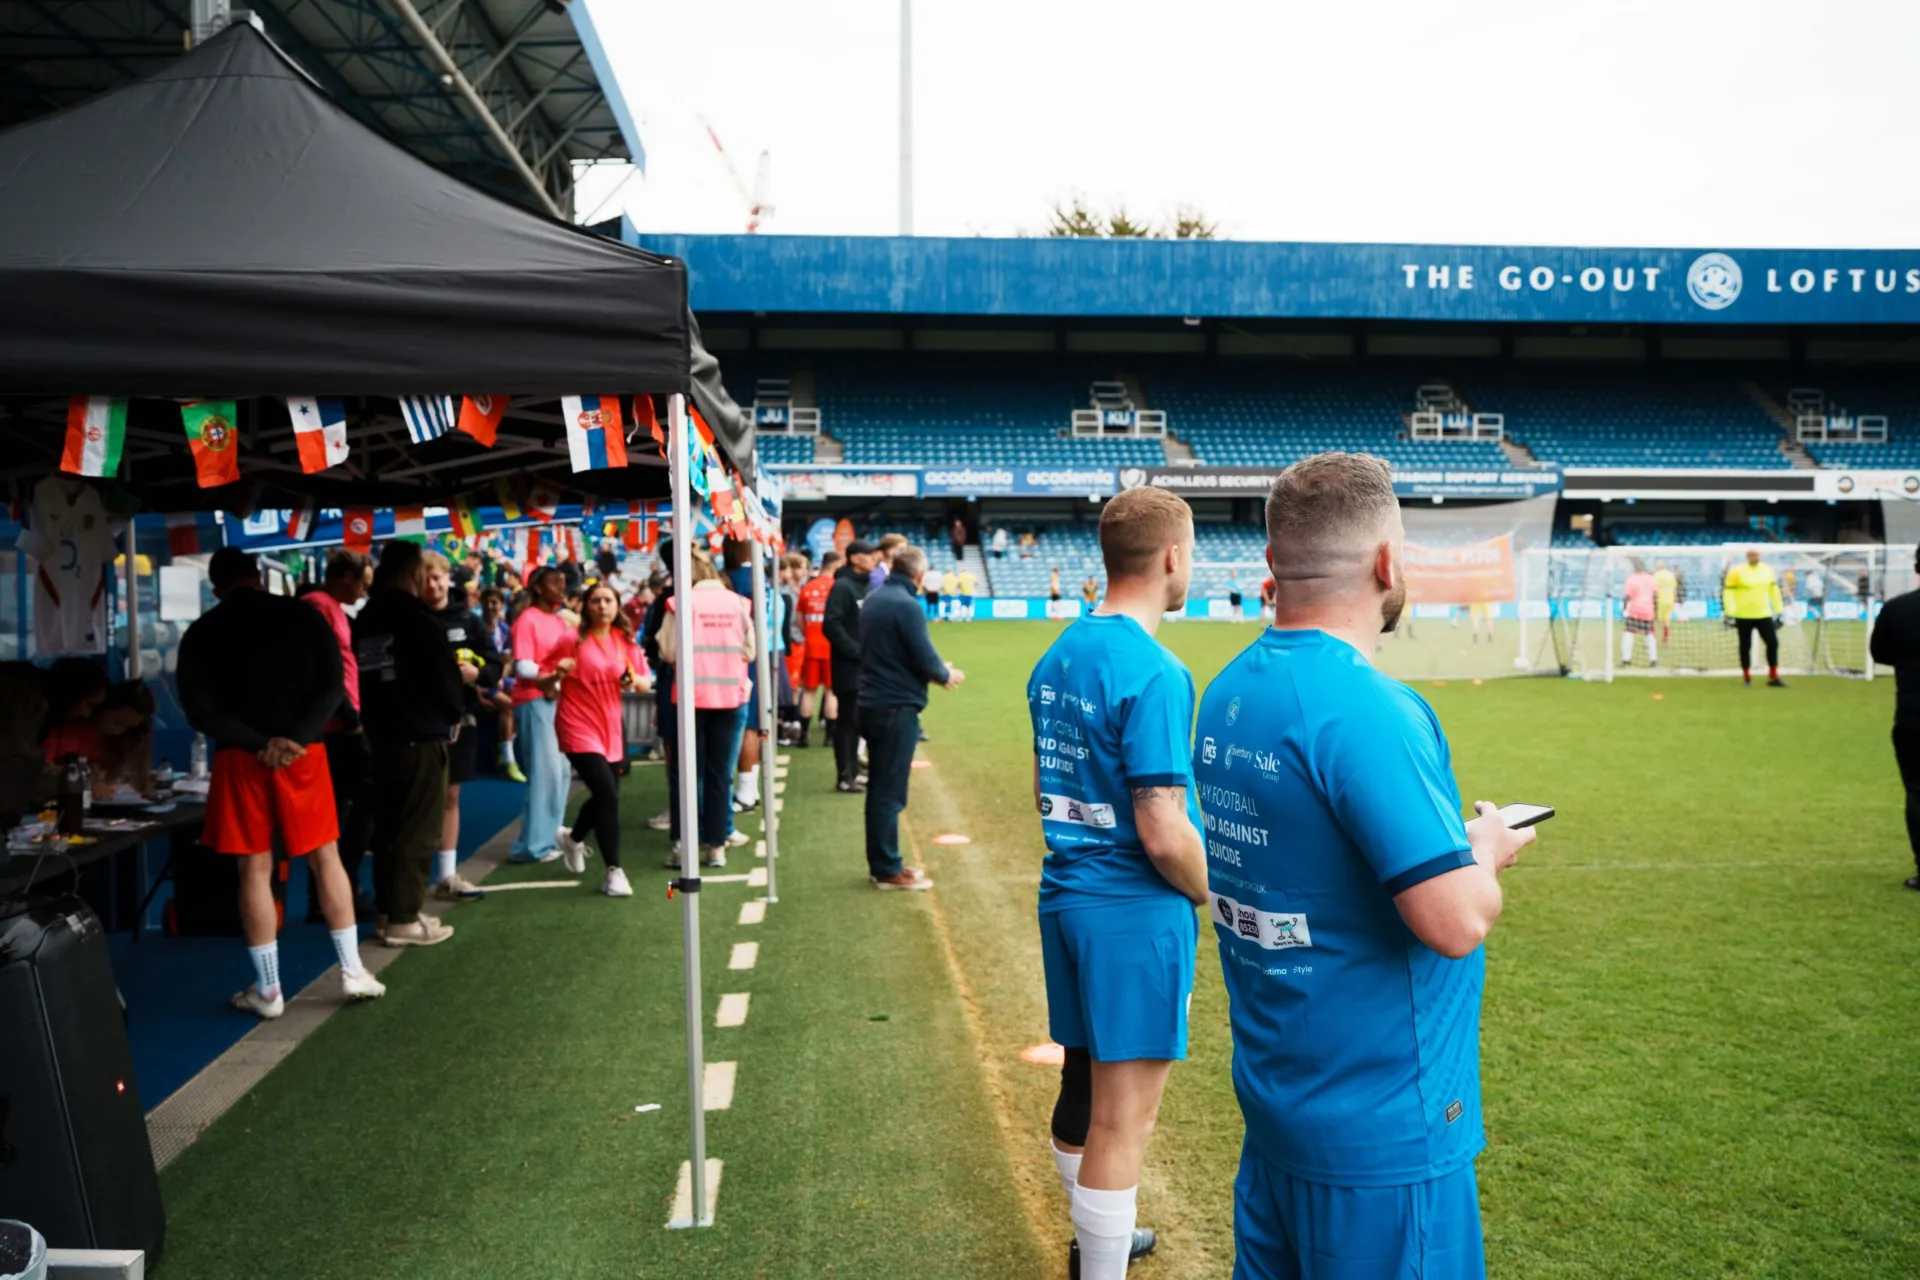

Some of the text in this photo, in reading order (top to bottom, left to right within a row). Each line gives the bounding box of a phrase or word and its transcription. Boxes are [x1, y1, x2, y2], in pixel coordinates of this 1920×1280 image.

[1401, 264, 1661, 292] THE GO-OUT
[1767, 268, 1920, 294] LOFTUS
[924, 468, 1014, 486] academia
[1026, 468, 1115, 486] academia
[1219, 475, 1277, 488] SECURITY
[1254, 749, 1281, 773] Sale
[1212, 786, 1260, 818] FOOTBALL
[1218, 817, 1269, 847] AGAINST
[1208, 839, 1242, 868] SUICIDE
